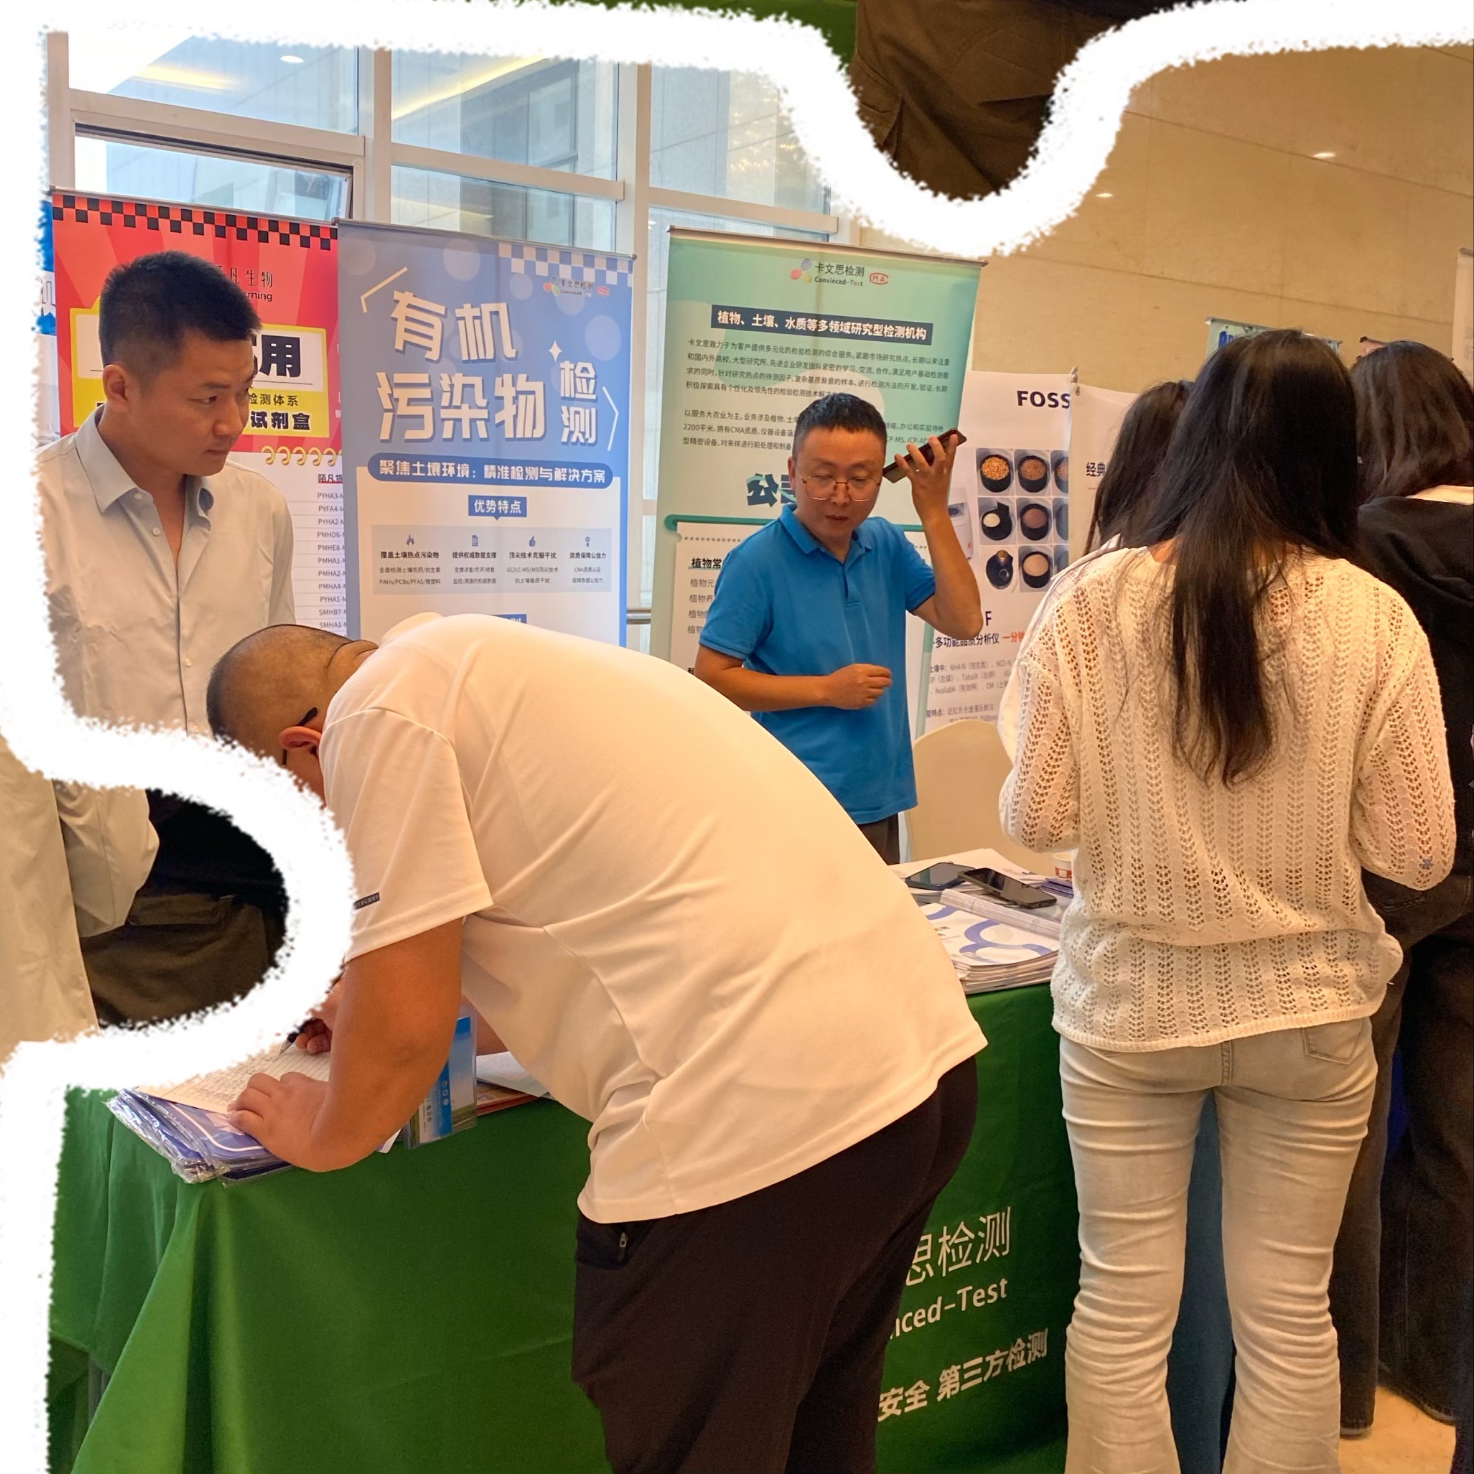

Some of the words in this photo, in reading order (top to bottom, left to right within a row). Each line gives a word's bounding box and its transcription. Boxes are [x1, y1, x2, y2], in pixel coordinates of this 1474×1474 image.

[218, 266, 273, 288] 凡生物
[814, 262, 865, 277] 卡文思检测
[814, 276, 864, 287] Convinced-Test
[390, 291, 517, 361] 有机
[717, 310, 927, 341] 植物、土壤、水质等多领域研究型检测机构
[377, 372, 546, 441] 污染物
[560, 360, 598, 445] 检测
[1017, 390, 1071, 409] FOSS
[250, 411, 311, 431] 试剂盒
[474, 499, 522, 514] 优势特点
[878, 1380, 930, 1422] 安全
[937, 1328, 1048, 1402] 第三方检测
